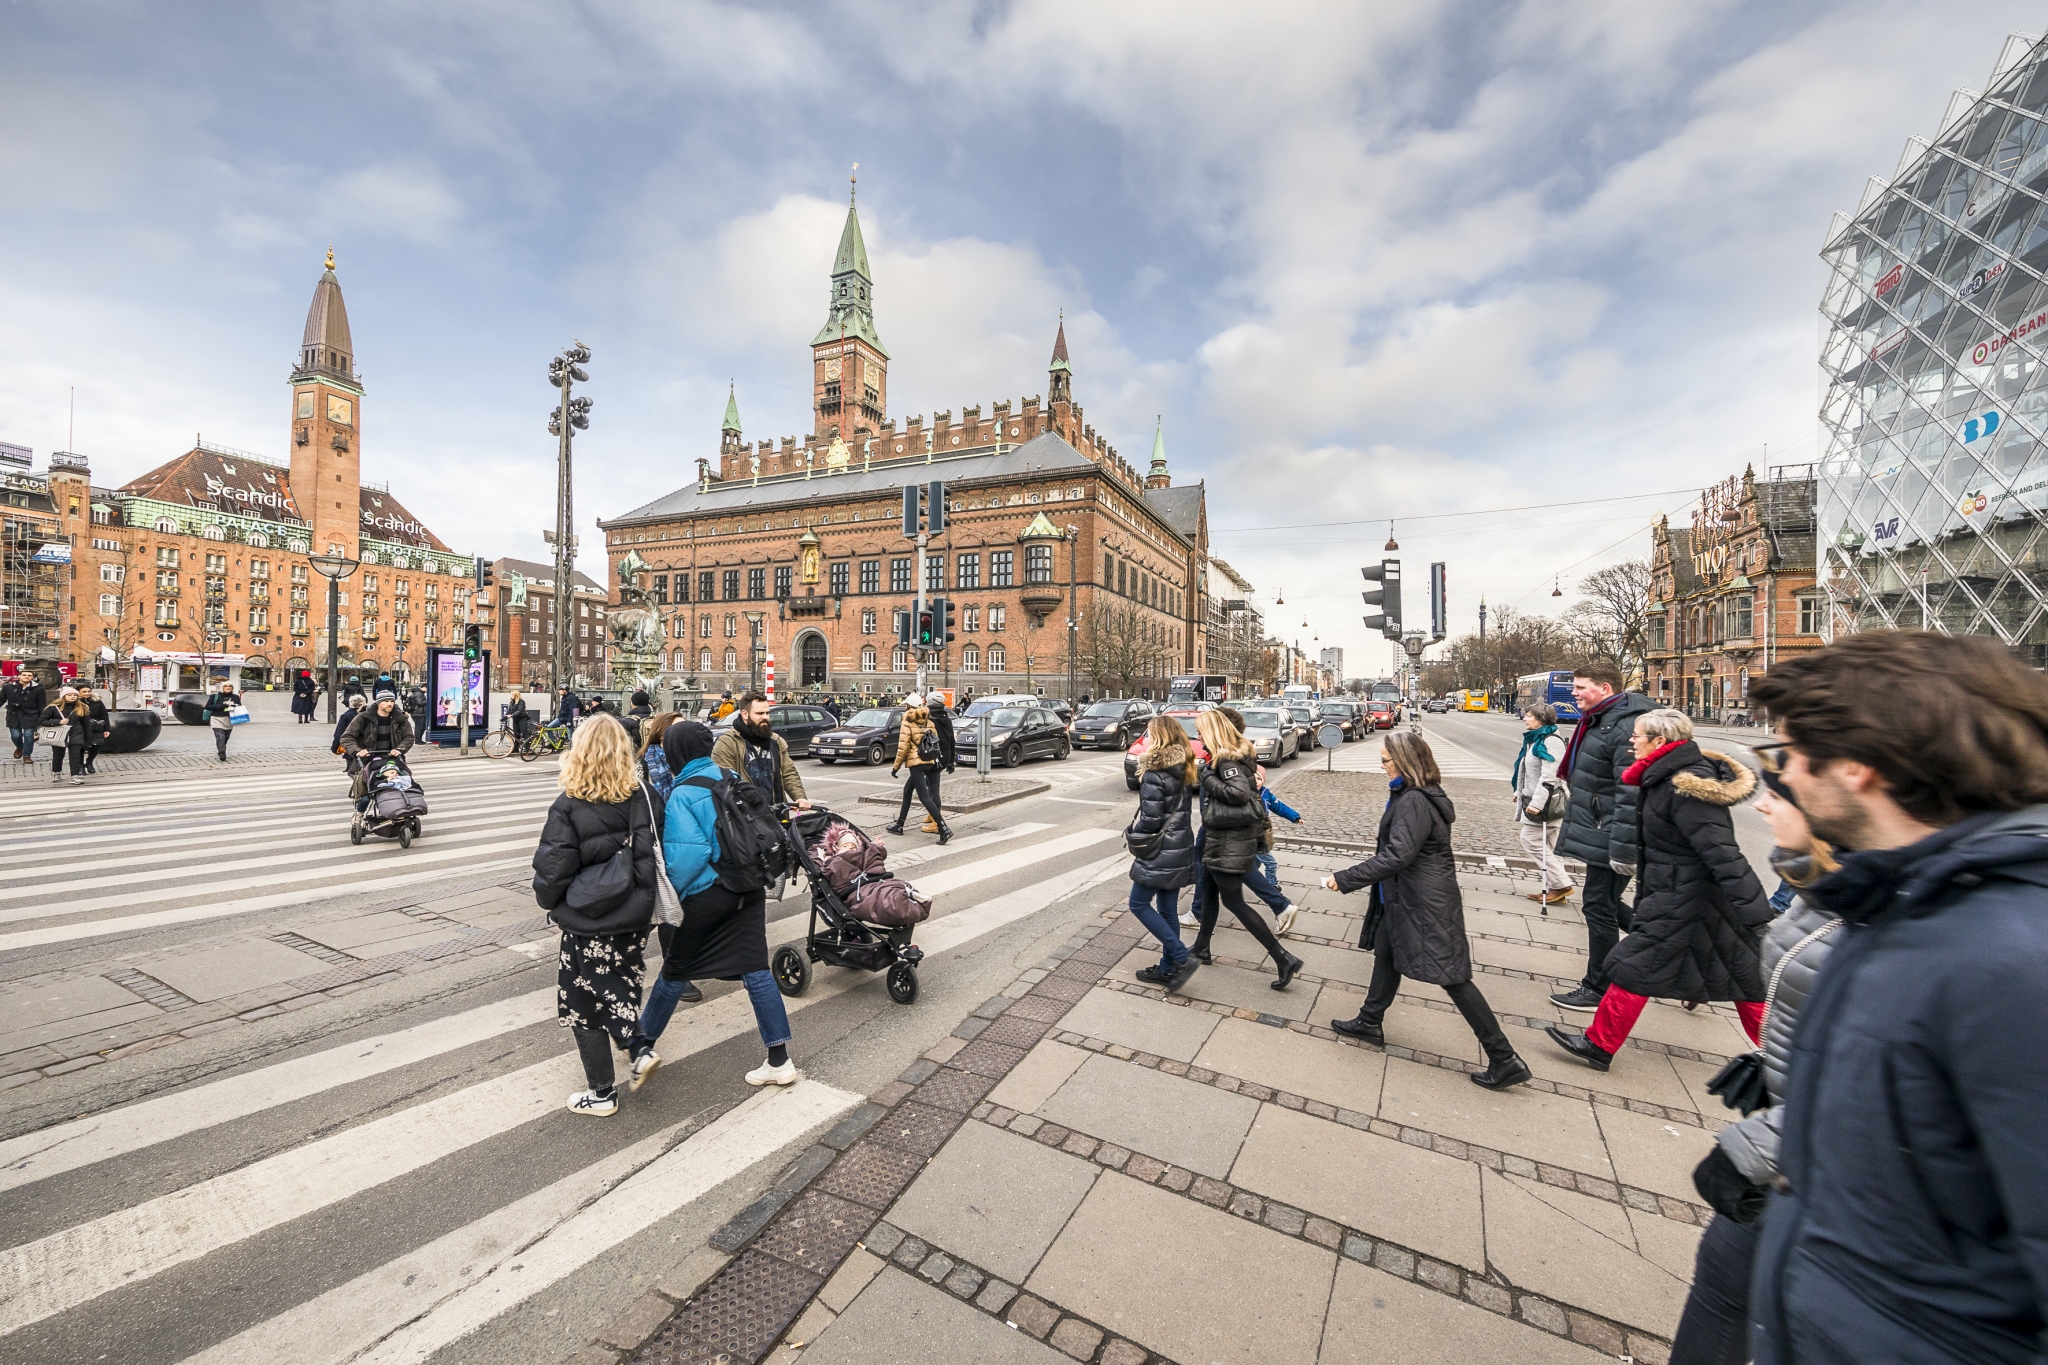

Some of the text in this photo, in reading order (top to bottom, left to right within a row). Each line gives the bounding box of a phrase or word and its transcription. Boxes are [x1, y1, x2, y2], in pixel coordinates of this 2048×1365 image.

[1958, 262, 2004, 300] SUPER DÆK
[3, 475, 46, 489] PLADS
[2019, 485, 2033, 495] AND
[206, 479, 294, 511] Scandic
[215, 514, 287, 536] PALACE
[363, 511, 427, 536] Scandic
[1874, 517, 1899, 542] AVK
[381, 543, 432, 561] HOTEL
[5, 646, 38, 656] KFC
